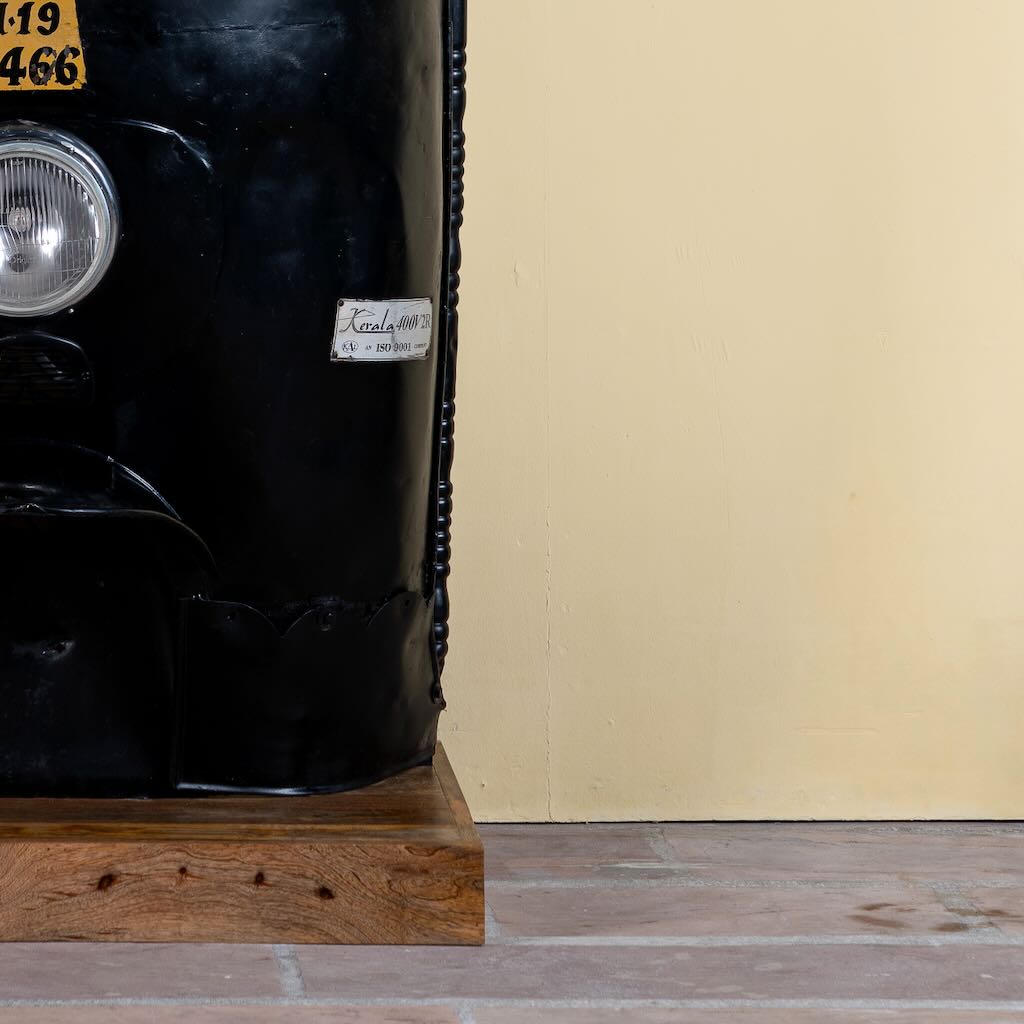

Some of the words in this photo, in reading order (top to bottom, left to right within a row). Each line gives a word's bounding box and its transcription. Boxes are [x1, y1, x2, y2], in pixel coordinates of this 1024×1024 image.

[339, 307, 395, 334] Kerala
[376, 343, 392, 352] ISO
[393, 342, 412, 352] 9001
